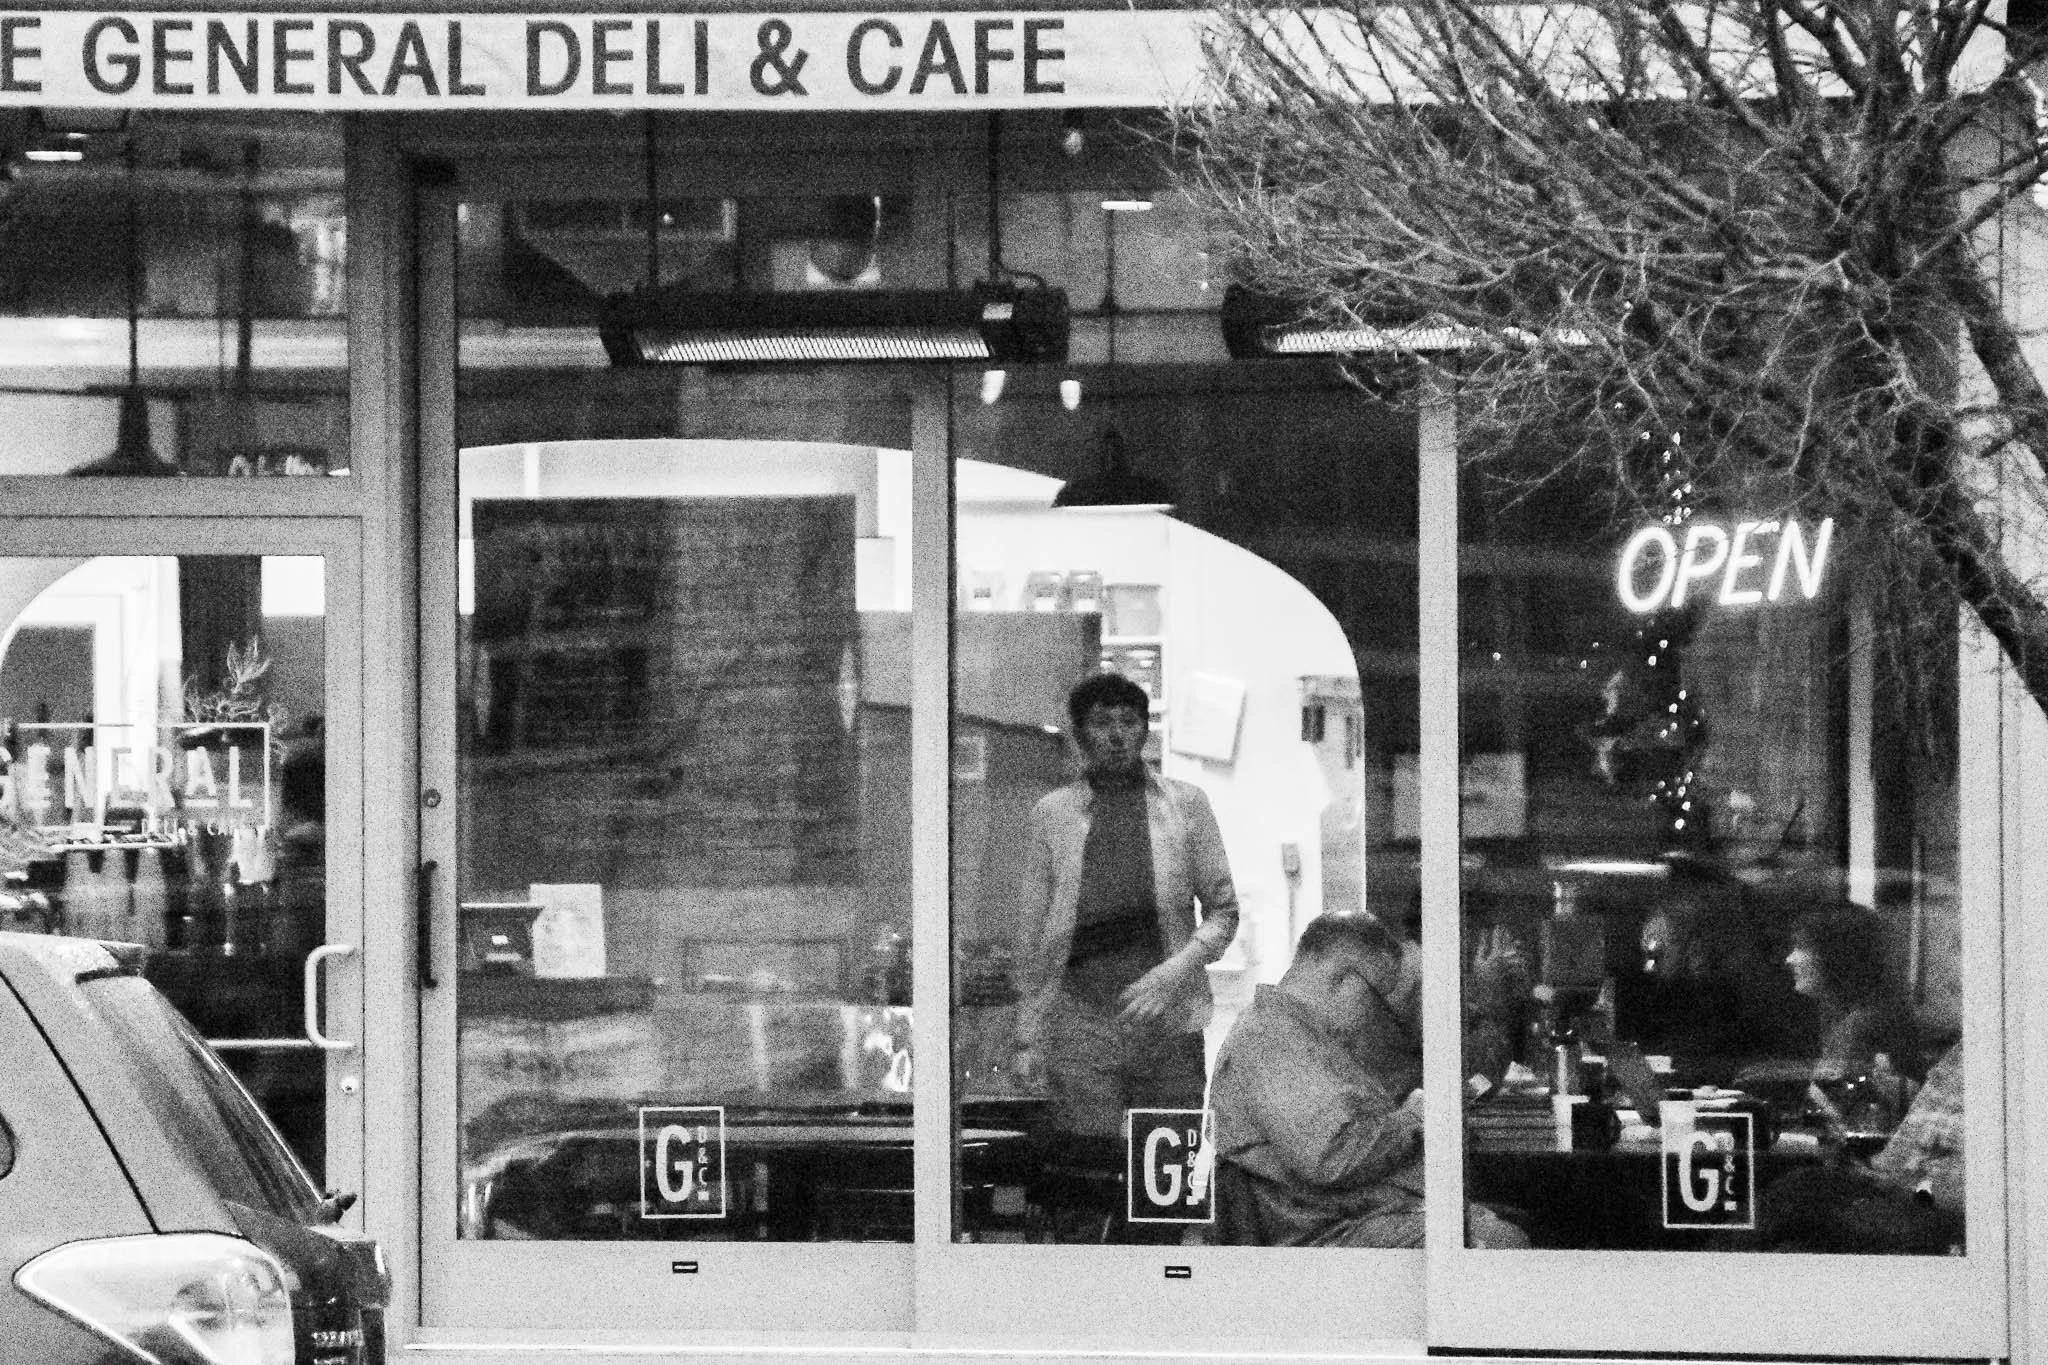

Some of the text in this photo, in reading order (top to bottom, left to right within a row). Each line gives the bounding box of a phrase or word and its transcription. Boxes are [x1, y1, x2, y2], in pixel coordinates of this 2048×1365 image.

[1, 17, 1065, 97] E GENERAL DELI & CAFE
[1617, 517, 1834, 612] OPEN
[656, 1125, 693, 1202] G
[1144, 1127, 1182, 1206] G
[1679, 1131, 1719, 1212] G
